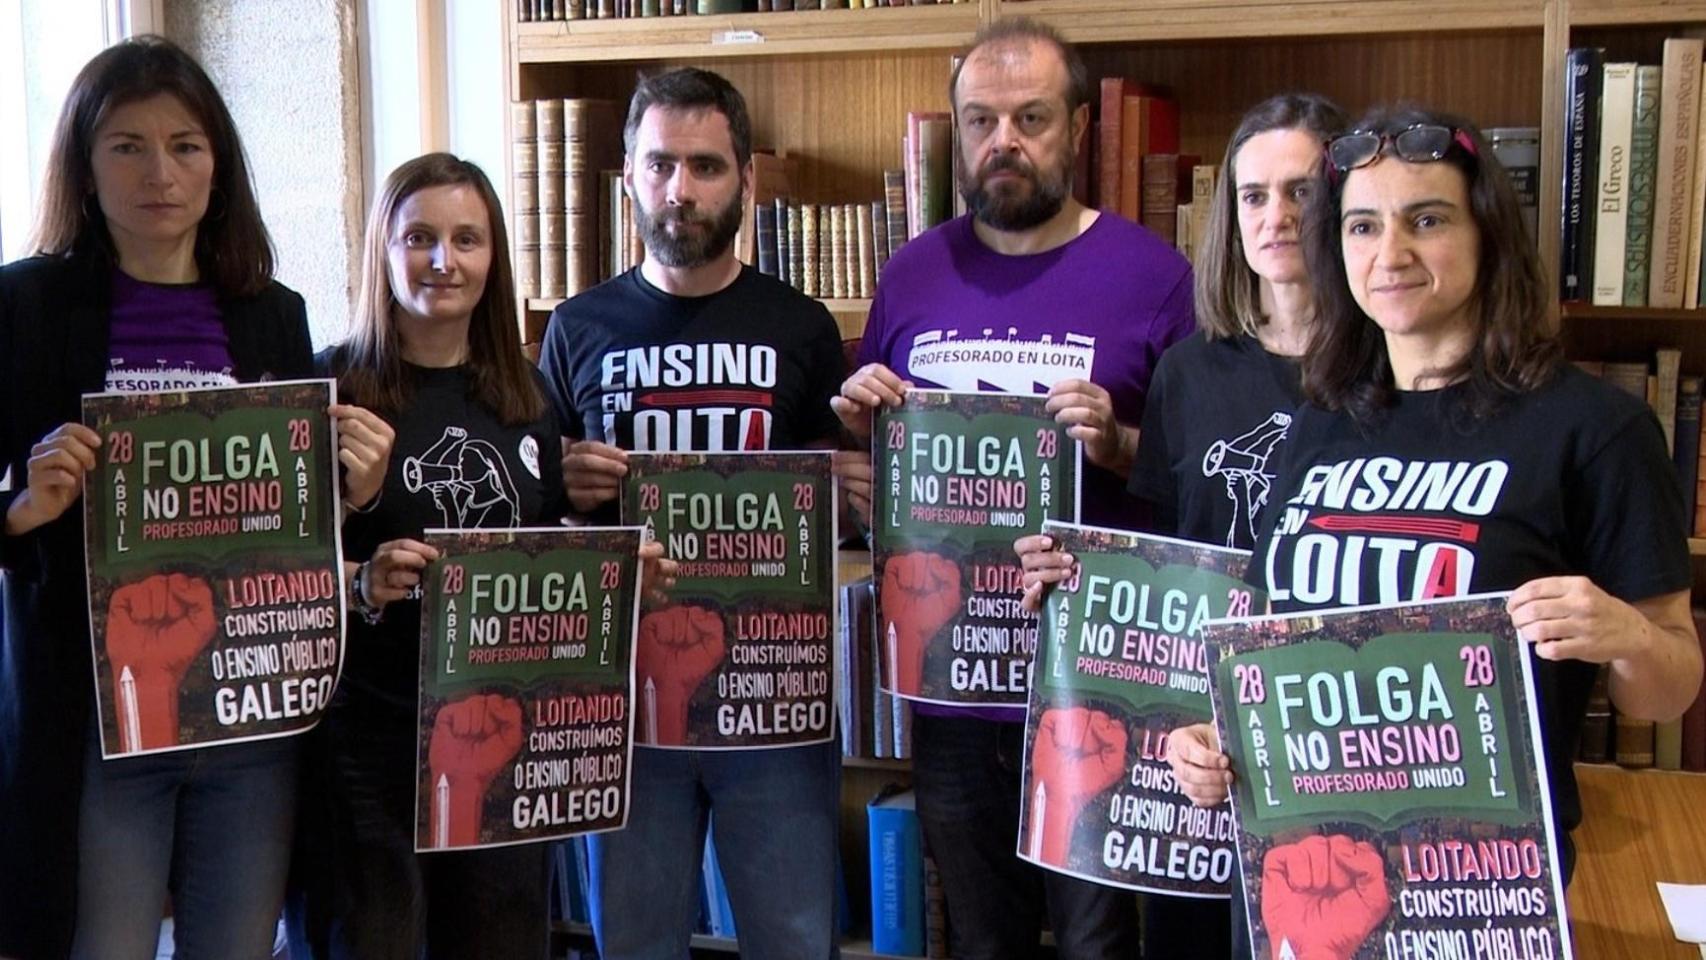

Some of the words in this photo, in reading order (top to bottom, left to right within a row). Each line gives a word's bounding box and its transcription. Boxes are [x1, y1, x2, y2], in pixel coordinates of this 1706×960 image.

[1574, 131, 1584, 150] DE
[1572, 151, 1584, 200] TESOROS
[1602, 145, 1623, 192] Greco
[1571, 205, 1580, 224] LOS
[1602, 193, 1620, 214] El
[601, 343, 776, 392] ENSINO
[912, 350, 1013, 368] PROFESORADO
[1018, 352, 1038, 364] EN
[1042, 353, 1086, 370] LOITA
[602, 392, 632, 412] EN
[108, 431, 132, 464] 28
[288, 419, 312, 452] 28
[888, 420, 906, 450] 28
[1036, 429, 1058, 458] 28
[142, 432, 280, 484] FOLGA
[912, 432, 1026, 478] FOLGA
[142, 491, 180, 521] NO
[188, 481, 282, 517] ENSINO
[296, 457, 309, 537] ABRIL
[640, 483, 660, 510] 28
[793, 483, 814, 510] 28
[890, 454, 900, 527] ABRIL
[910, 475, 939, 504] NO
[946, 477, 1026, 509] ENSINO
[1040, 463, 1051, 520] ABRI
[1287, 457, 1509, 516] ENSINO
[113, 469, 129, 552] ABRIL
[142, 520, 238, 540] PROFESORADO
[242, 514, 282, 533] UNIDO
[668, 492, 784, 531] FOLGA
[911, 506, 987, 525] PROFESORADO
[990, 512, 1026, 528] UNIDO
[669, 532, 698, 560] NO
[706, 532, 786, 560] ENSINO
[798, 514, 810, 585] ABRIL
[444, 564, 464, 594] 28
[600, 561, 620, 590] 28
[677, 562, 748, 577] ROFESORADO
[752, 562, 786, 577] UNIDO
[974, 566, 1026, 594] LOITA
[1266, 534, 1475, 604] LOITA
[228, 571, 334, 609] LOITANDO
[471, 572, 588, 614] FOLGA
[968, 596, 1038, 620] CONSTR
[1084, 575, 1210, 637] FOLGA
[1226, 588, 1250, 618] 28
[225, 604, 335, 638] CONSTRUÍMOS
[446, 599, 456, 674] ABRIL
[469, 617, 500, 645] NO
[508, 614, 588, 643] ENSINO
[600, 594, 612, 665] ABRIL
[736, 612, 828, 642] LOITANDO
[953, 624, 960, 651] O
[964, 624, 1010, 654] ENSINO
[1053, 597, 1070, 677] ABRIL
[212, 652, 224, 681] O
[226, 644, 280, 681] ENSINO
[282, 635, 336, 674] PÚBLICO
[468, 647, 548, 664] PROFESORADO
[552, 644, 586, 660] UNIDO
[732, 641, 826, 666] CONSTRUÍMOS
[1079, 621, 1115, 658] NO
[1122, 629, 1208, 673] ENSINO
[1460, 645, 1495, 687] 28
[718, 674, 727, 699] O
[728, 673, 774, 699] ENSINO
[777, 668, 828, 696] PÚBLICO
[951, 658, 1032, 692] GALE
[1076, 656, 1166, 686] PROFESORADO
[1169, 673, 1208, 694] UNIDO
[1234, 664, 1266, 704] 28
[215, 675, 334, 726] GALEGO
[536, 696, 624, 728] LOITANDO
[1274, 662, 1454, 730] FOLGA
[717, 701, 826, 736] GALEGO
[530, 723, 622, 753] CONSTRUÍMOS
[1284, 730, 1331, 772] NO
[1338, 723, 1462, 769] ENSINO
[1475, 692, 1506, 798] ABRIL
[514, 764, 525, 790] O
[526, 758, 570, 790] ENSINO
[572, 750, 622, 784] PÚBLICO
[1248, 710, 1280, 806] ABRIL
[1293, 772, 1410, 794] PROFESORADO
[1413, 767, 1466, 789] UNIDO
[512, 786, 620, 829] GALEGO
[1110, 794, 1120, 823] O
[1122, 795, 1175, 834] ENSINO
[1103, 830, 1232, 884] GALEGO
[1400, 839, 1542, 882] LOITANDO
[1400, 881, 1547, 918] CONSTRUÍMOS
[1385, 932, 1400, 960] O
[1400, 928, 1470, 960] ENSINO
[1472, 918, 1554, 960] PÚBLICO
